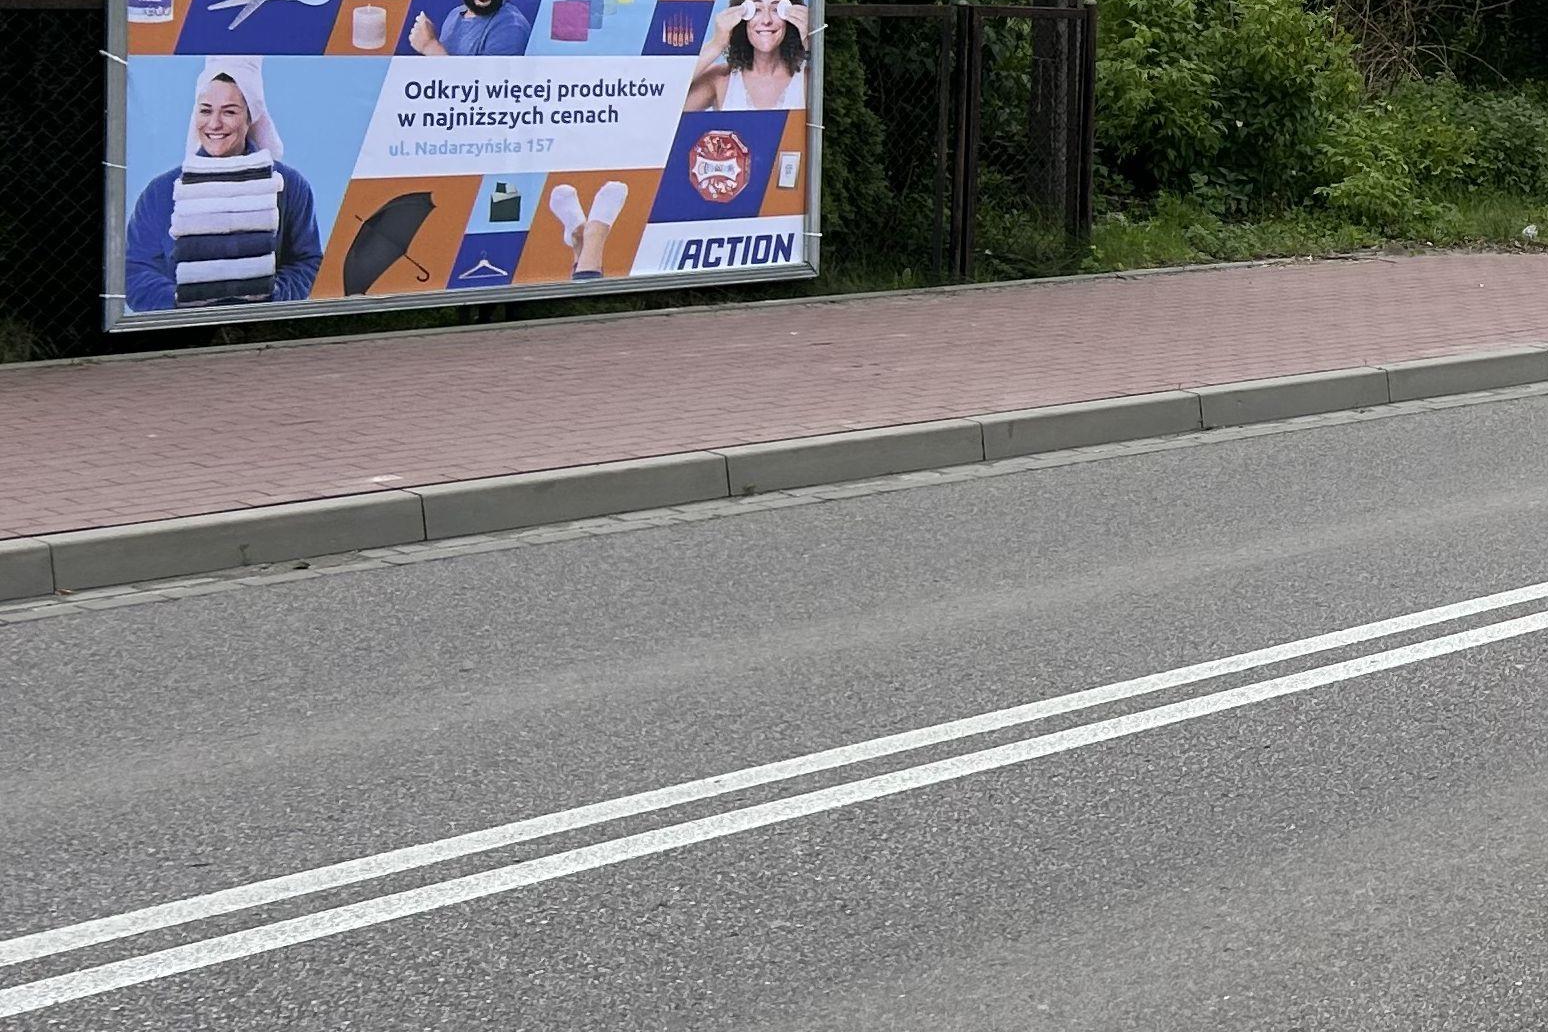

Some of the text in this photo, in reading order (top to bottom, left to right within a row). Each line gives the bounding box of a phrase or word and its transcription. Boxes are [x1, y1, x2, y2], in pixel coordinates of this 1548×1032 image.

[404, 77, 665, 103] Odkryj więcej produktów
[397, 104, 619, 130] w najniższych cenach
[388, 137, 555, 157] ul. Nadarzyńska 157
[677, 232, 795, 271] ACTION
